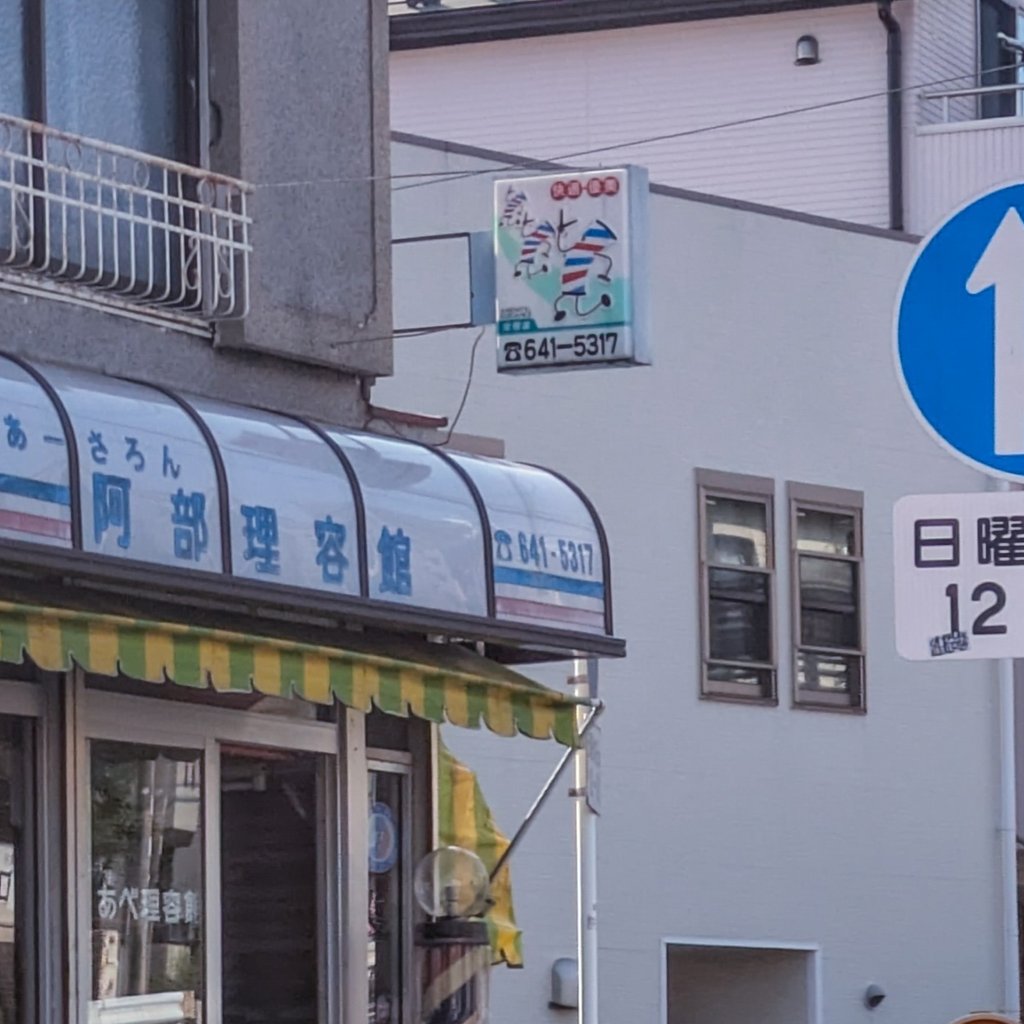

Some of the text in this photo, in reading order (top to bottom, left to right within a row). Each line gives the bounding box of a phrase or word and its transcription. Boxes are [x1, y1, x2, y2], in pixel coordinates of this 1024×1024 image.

[524, 333, 618, 361] 641-5317
[92, 472, 412, 597] 阿部理容館
[518, 531, 594, 576] 641-5317
